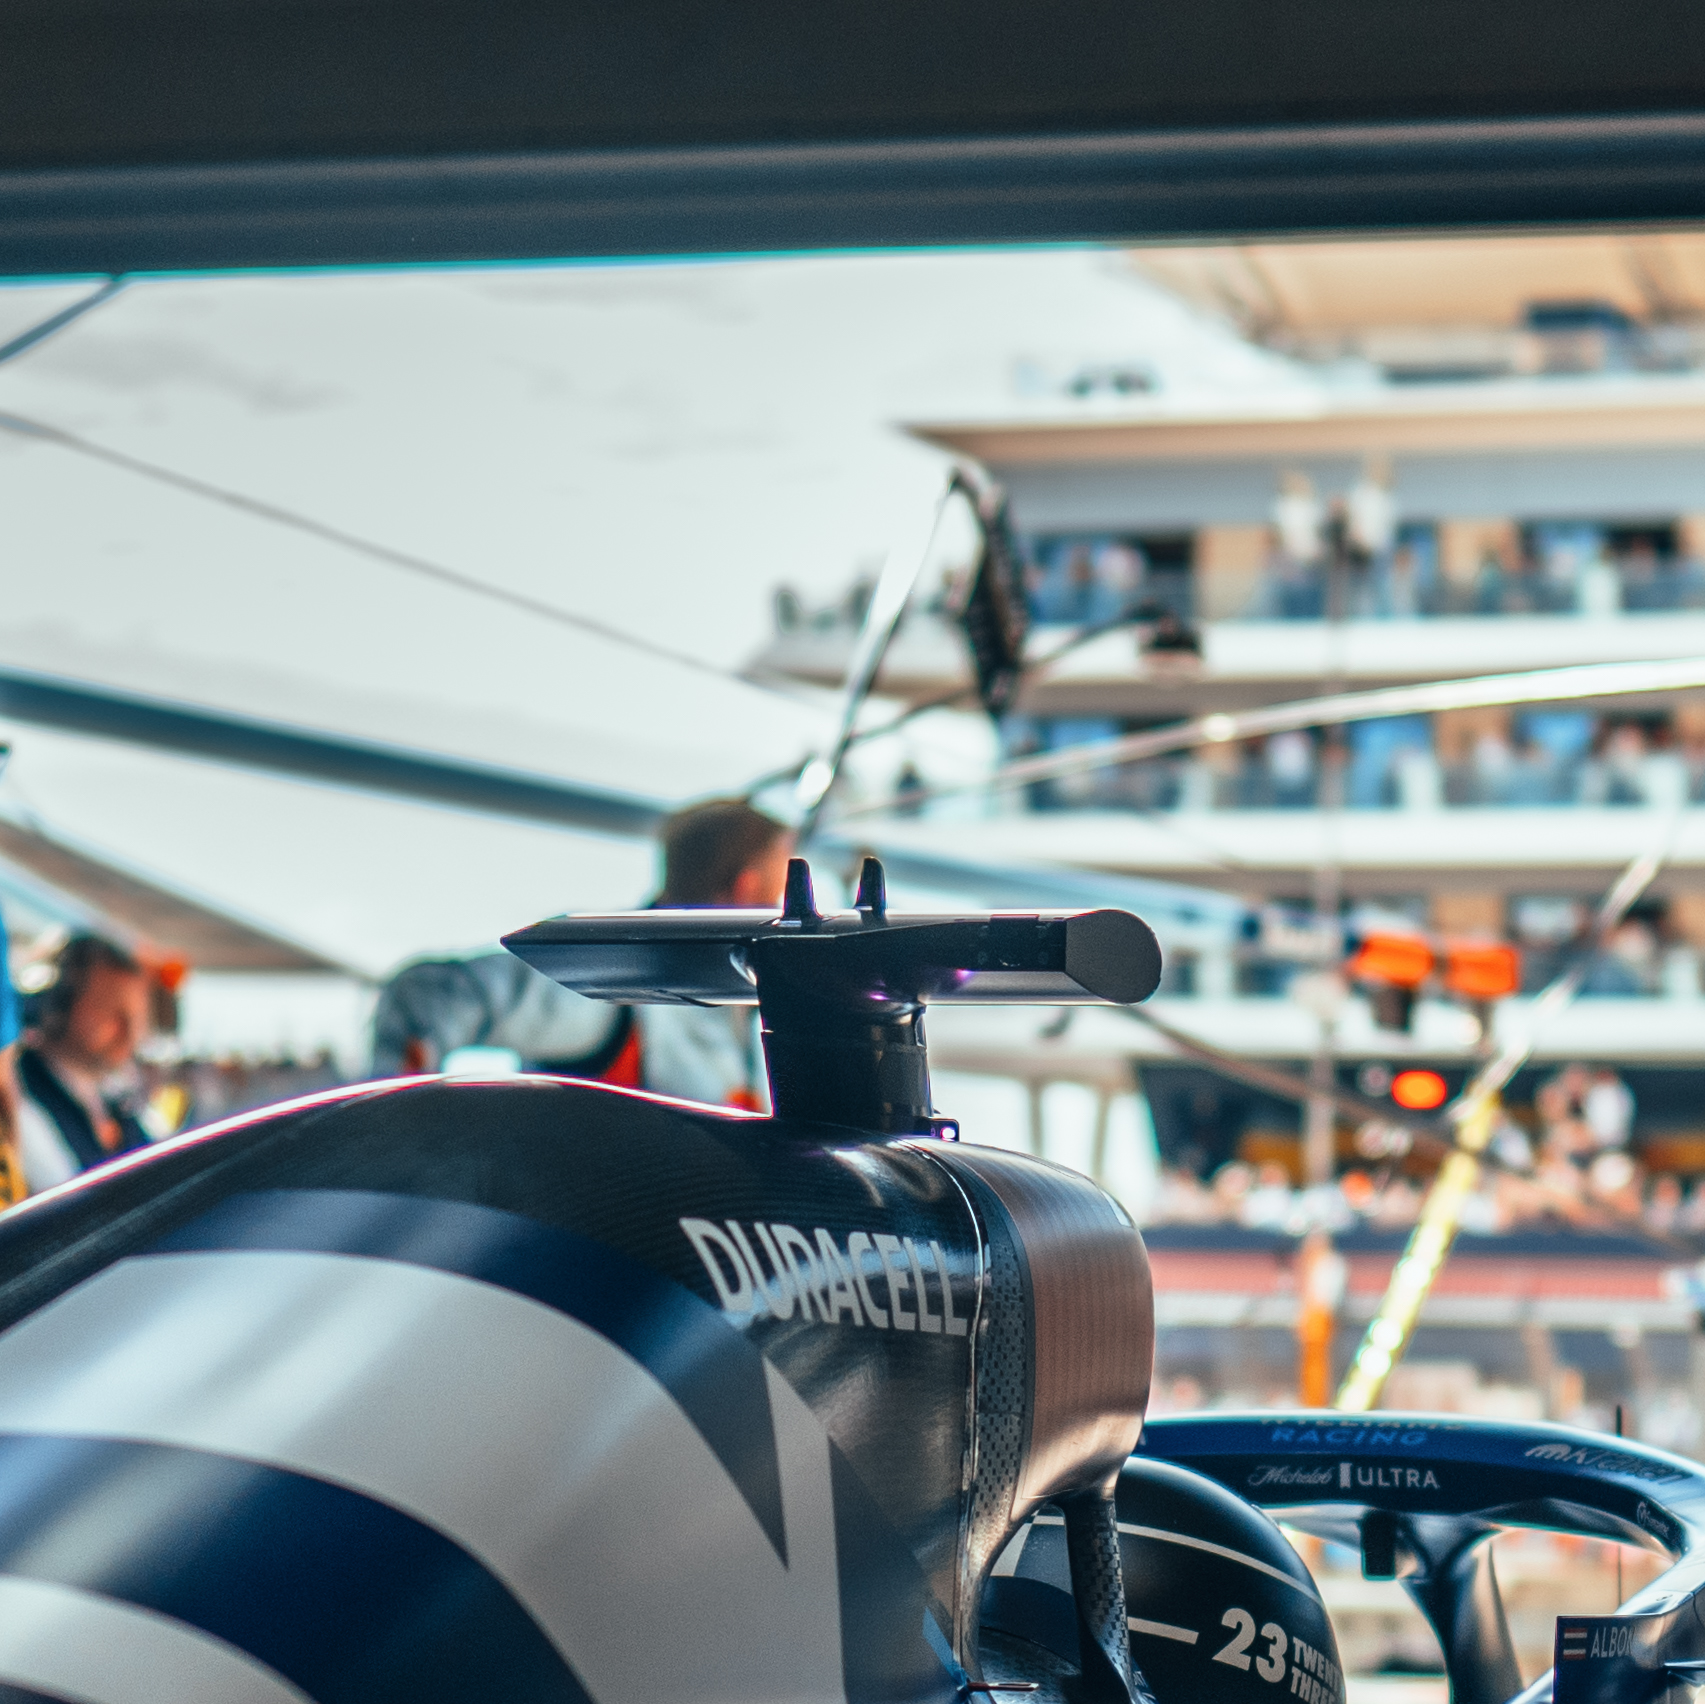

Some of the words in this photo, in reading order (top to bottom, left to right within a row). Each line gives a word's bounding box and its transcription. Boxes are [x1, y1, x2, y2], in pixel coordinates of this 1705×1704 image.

[679, 1217, 968, 1337] DURACELL
[1271, 1428, 1428, 1446] RACING
[1357, 1466, 1439, 1489] ULTRA
[1212, 1608, 1288, 1683] 23
